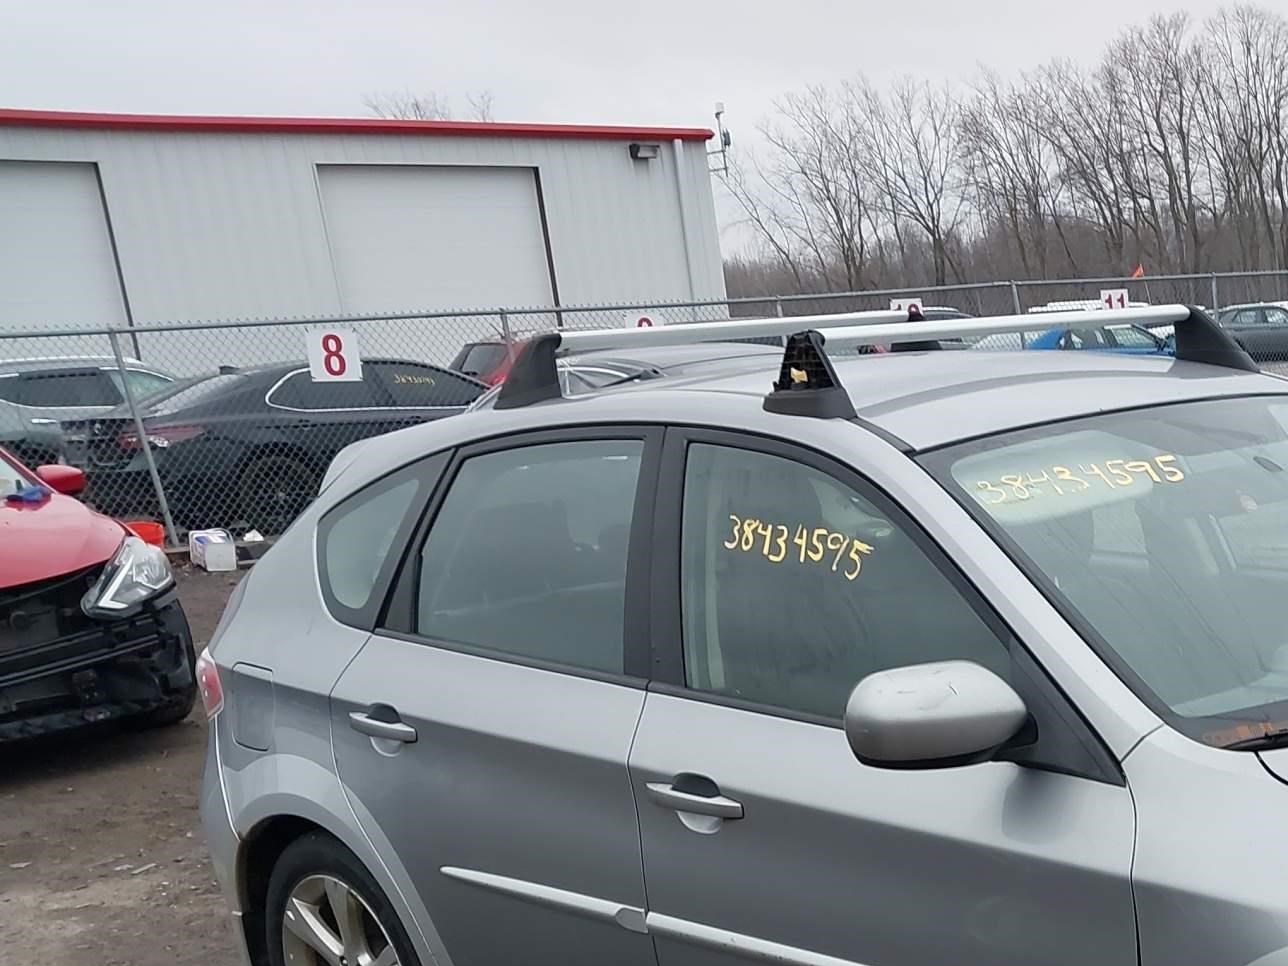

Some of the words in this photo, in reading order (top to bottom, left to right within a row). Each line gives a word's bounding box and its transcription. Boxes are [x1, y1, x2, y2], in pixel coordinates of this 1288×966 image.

[322, 334, 346, 376] 8
[977, 454, 1185, 505] 38434595
[724, 514, 875, 580] 38434595
